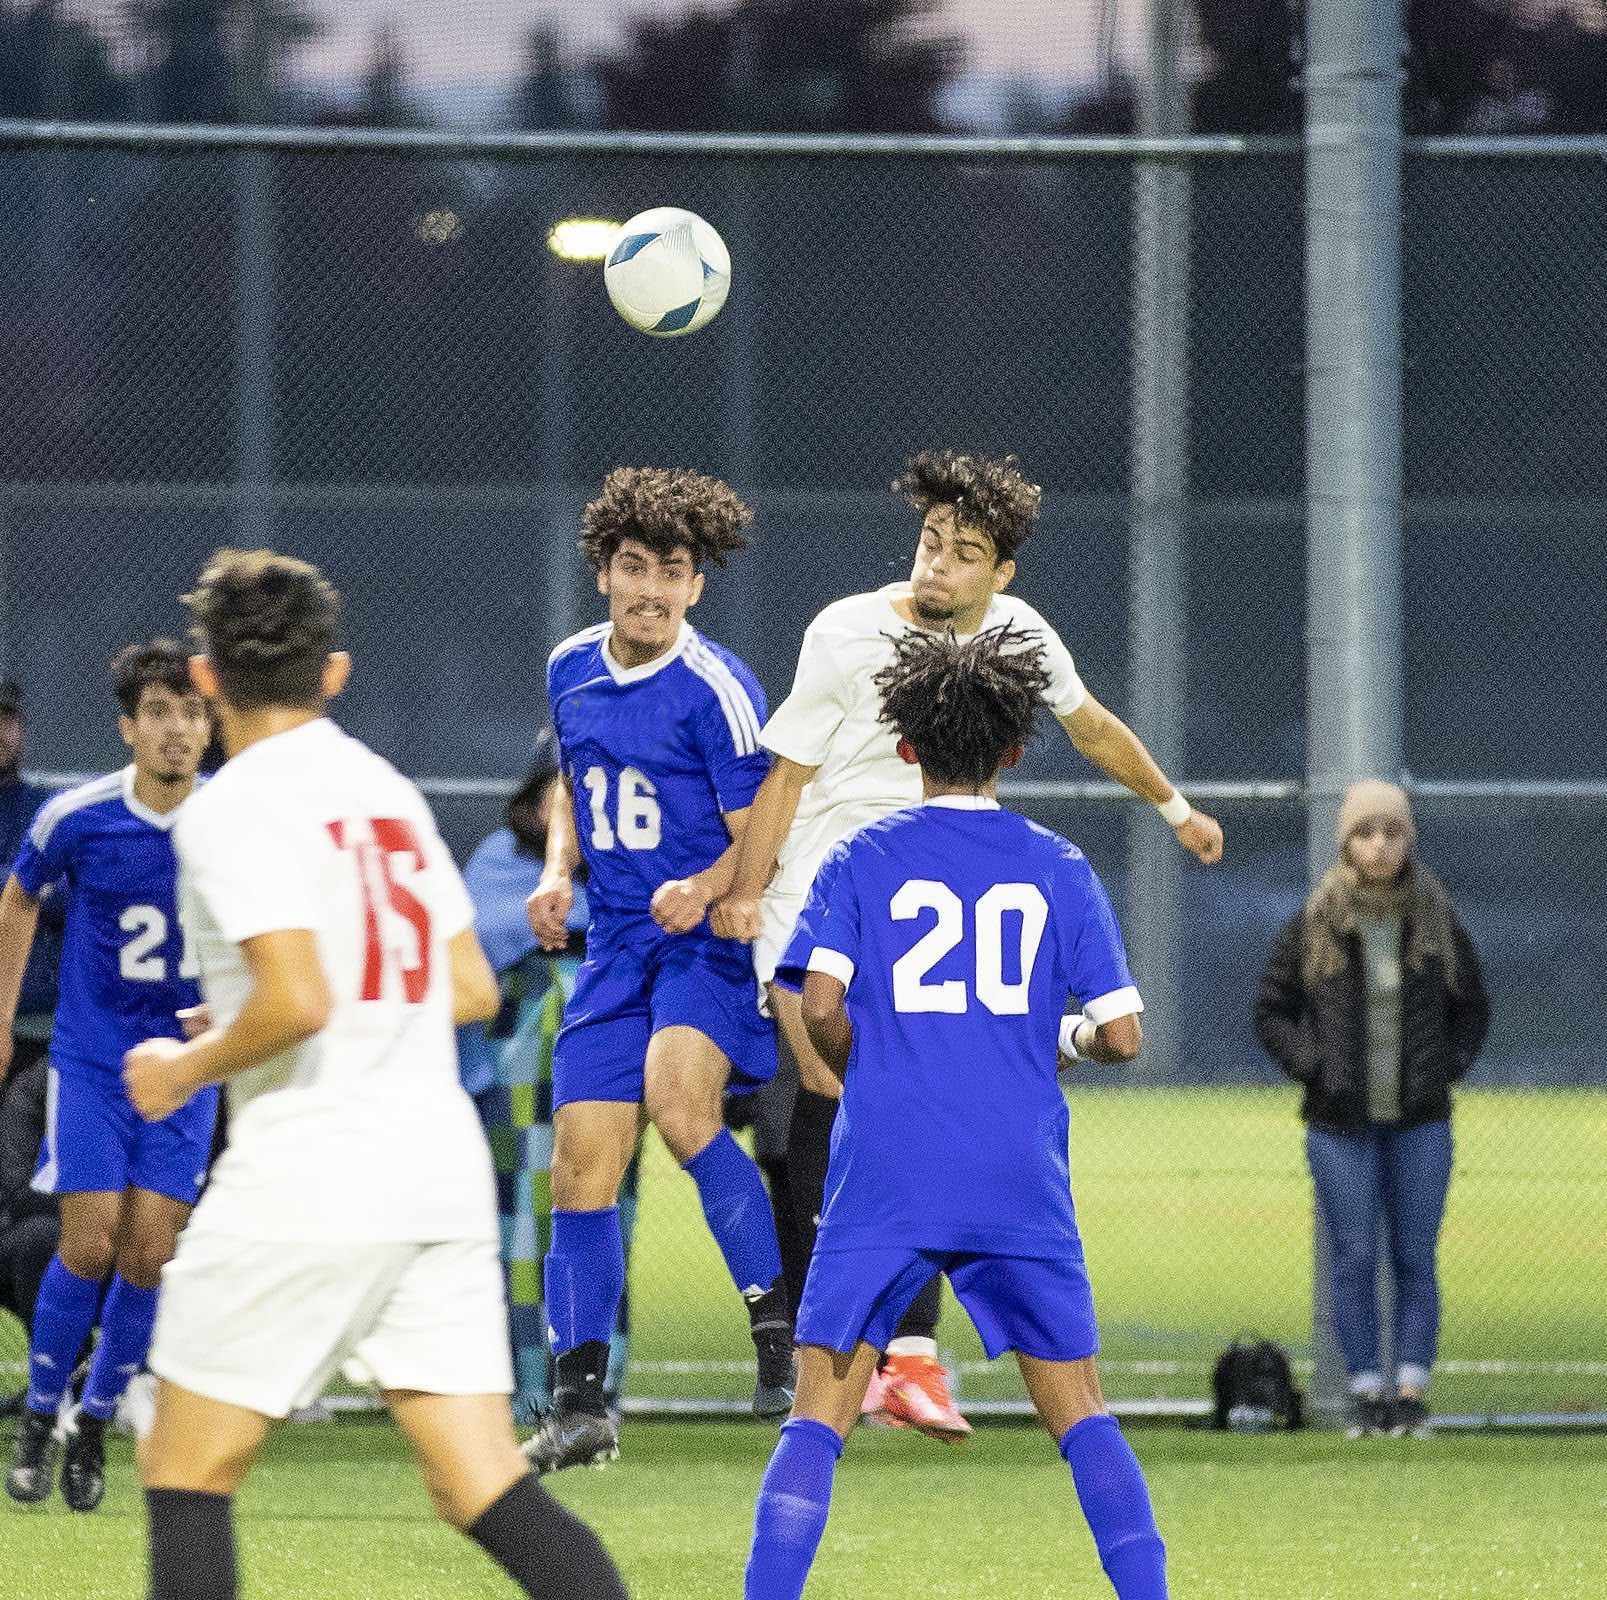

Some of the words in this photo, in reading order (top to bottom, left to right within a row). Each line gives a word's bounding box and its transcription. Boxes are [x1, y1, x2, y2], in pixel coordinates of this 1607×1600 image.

[583, 765, 662, 850] 16
[324, 817, 432, 1003] 15
[889, 878, 1049, 1016] 20
